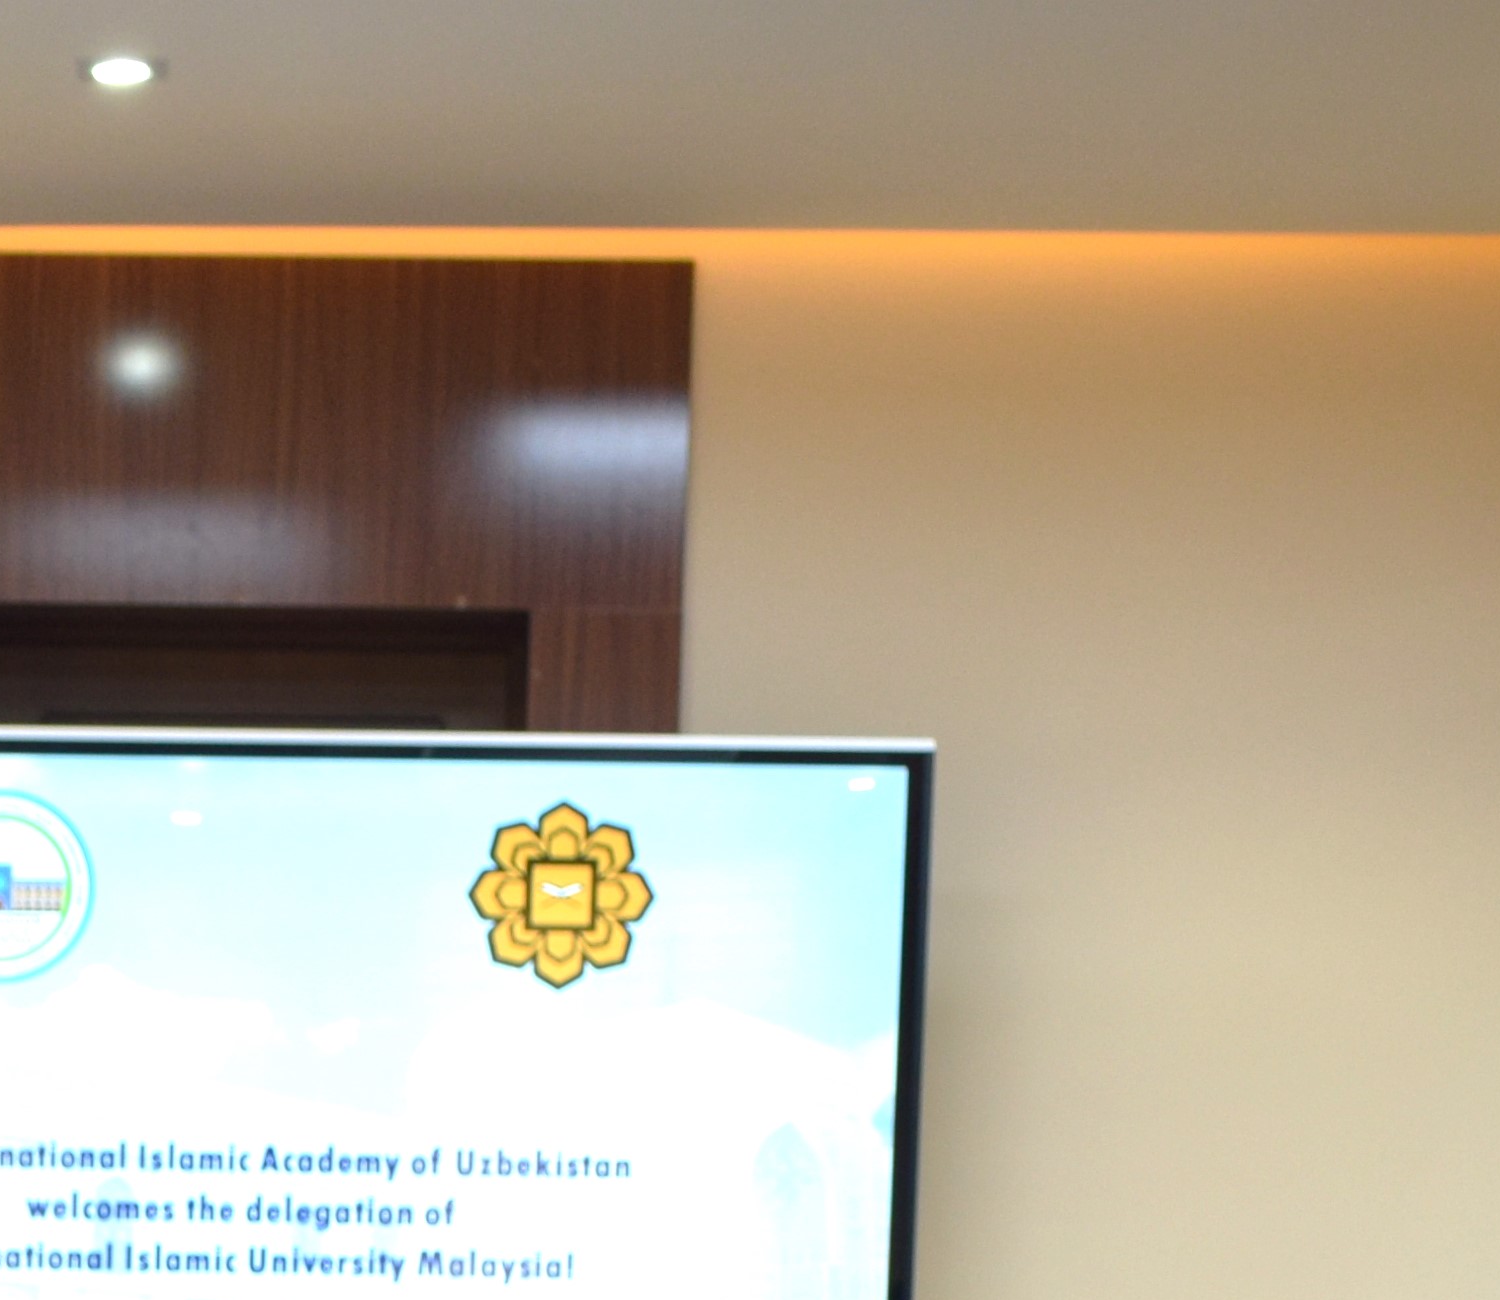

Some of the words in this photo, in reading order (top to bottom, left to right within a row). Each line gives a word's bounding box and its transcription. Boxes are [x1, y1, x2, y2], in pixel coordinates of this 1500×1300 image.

[137, 1141, 250, 1172] Islamic
[260, 1144, 400, 1182] Academy
[411, 1147, 442, 1176] of
[456, 1148, 631, 1178] Uzbekistan
[26, 1191, 174, 1222] welcomes
[186, 1193, 235, 1223] the
[245, 1194, 414, 1233] delegation
[425, 1199, 455, 1226] of
[123, 1241, 237, 1274] Islamic
[248, 1244, 406, 1283] University
[418, 1250, 574, 1284] Malaysia!
